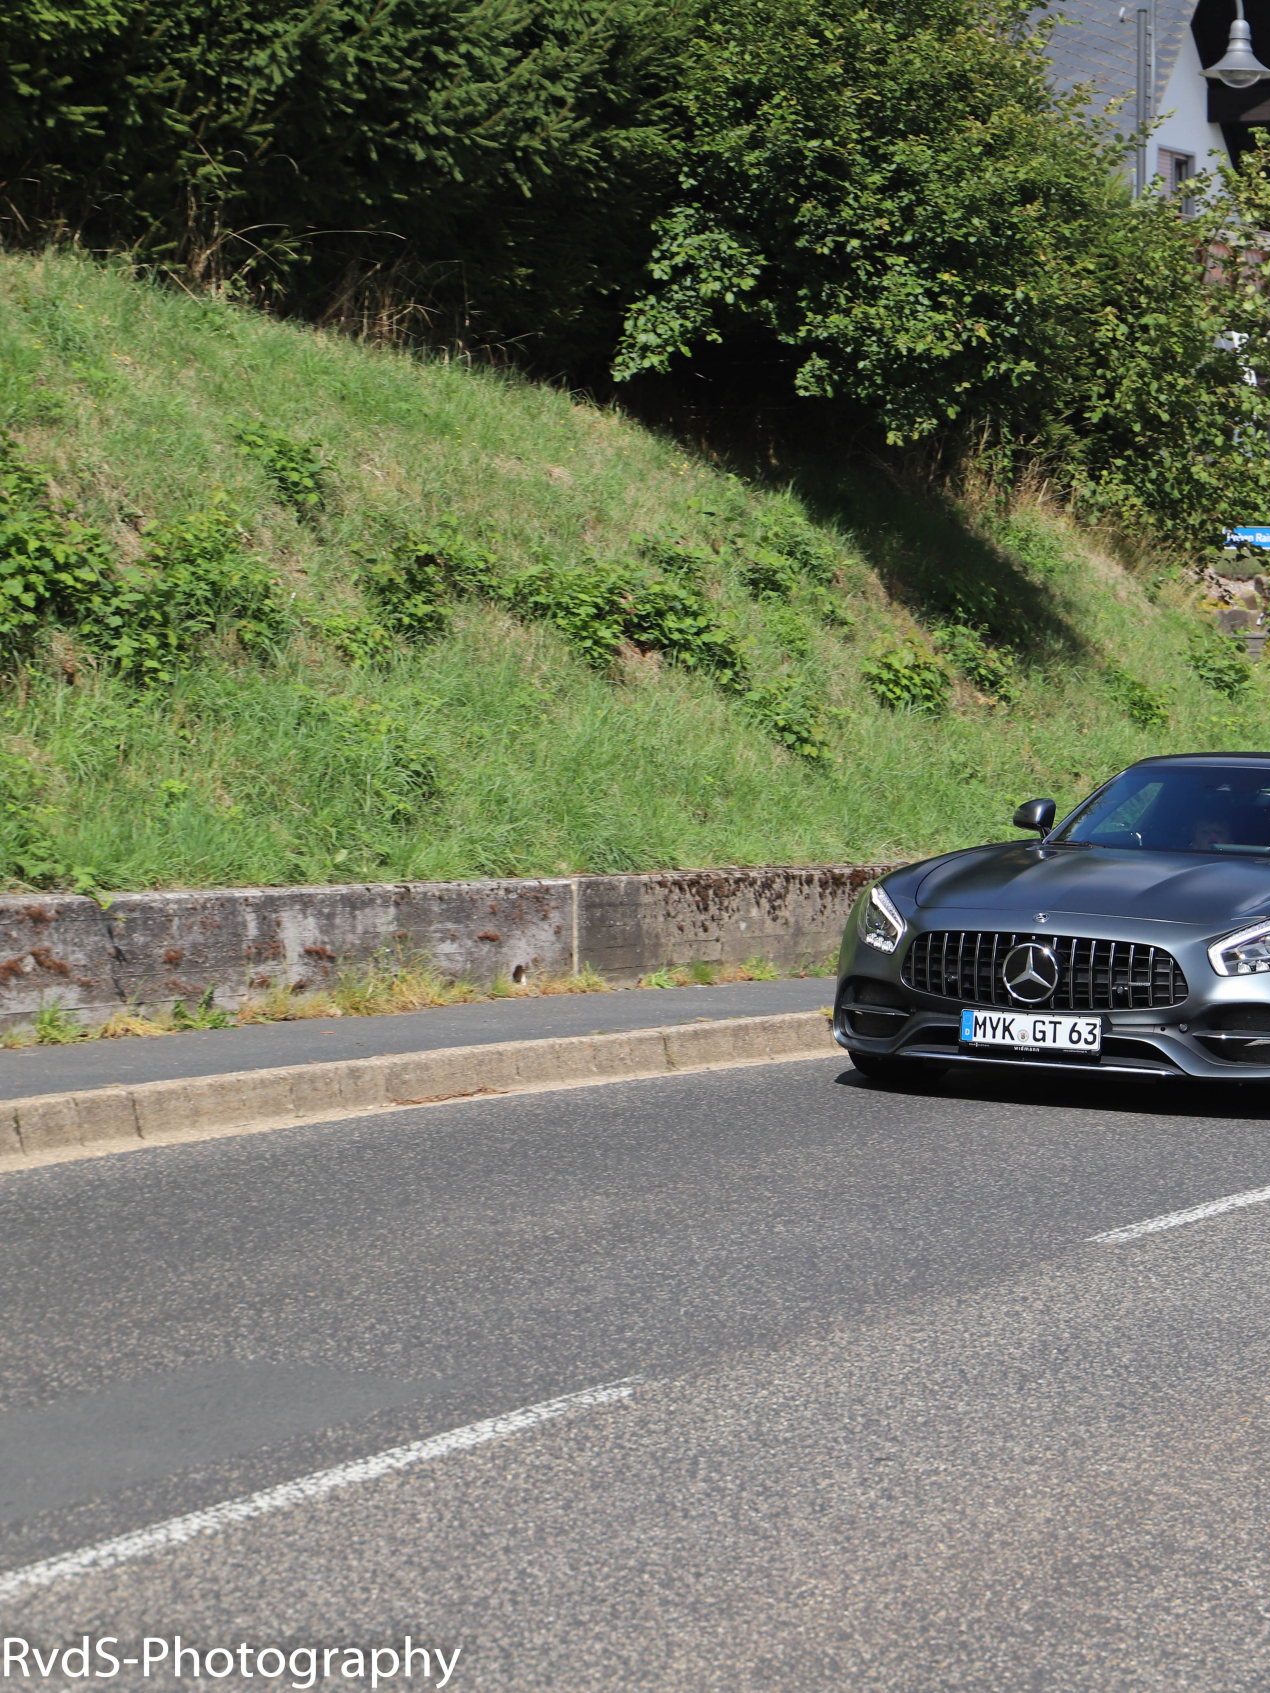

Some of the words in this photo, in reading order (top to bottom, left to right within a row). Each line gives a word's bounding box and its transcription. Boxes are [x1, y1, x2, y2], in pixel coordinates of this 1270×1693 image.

[973, 1015, 1015, 1041] MYK
[1032, 1020, 1062, 1043] GT
[1069, 1022, 1098, 1046] 63
